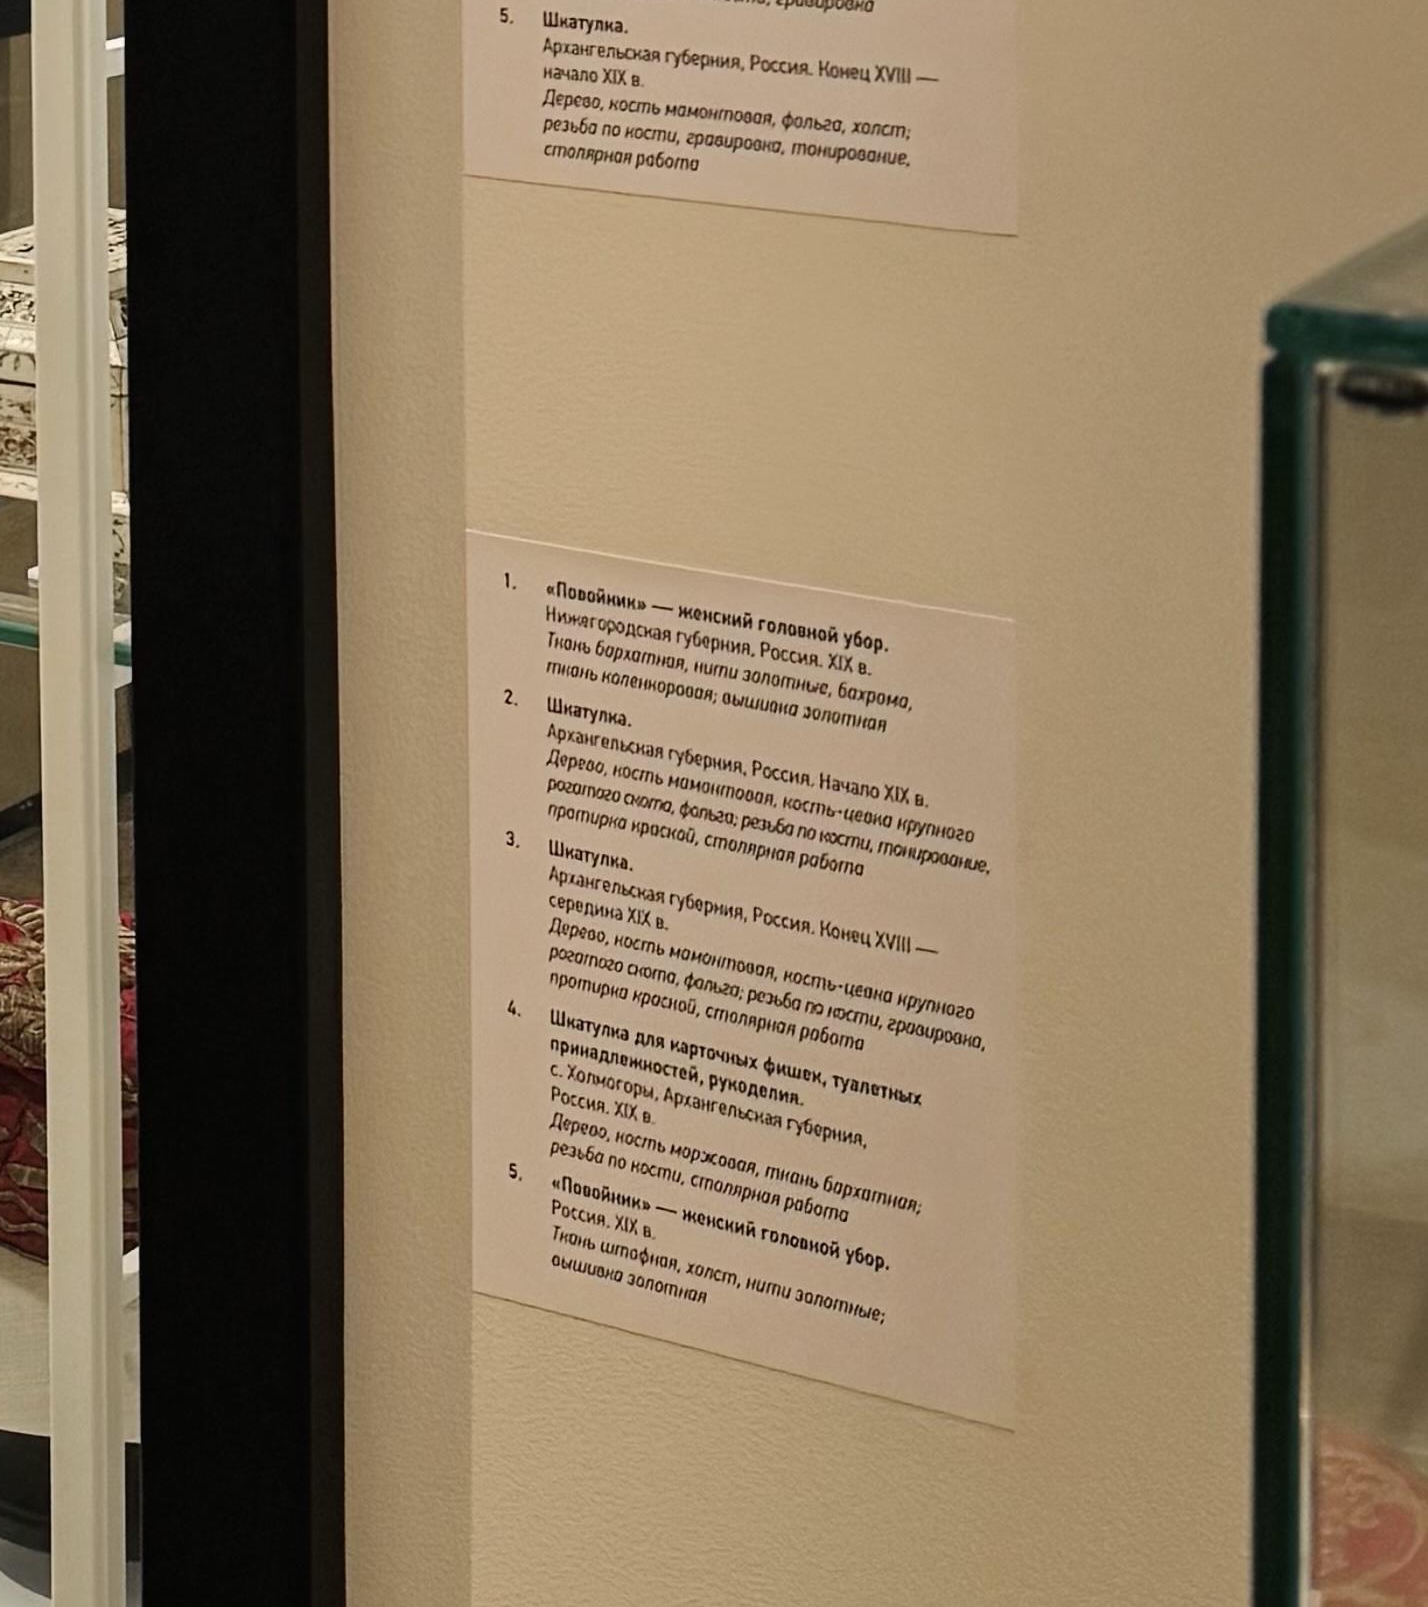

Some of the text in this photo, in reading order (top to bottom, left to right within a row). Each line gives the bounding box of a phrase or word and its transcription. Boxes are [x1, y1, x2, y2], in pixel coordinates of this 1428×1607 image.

[498, 6, 629, 36] 5. Шкатулка.
[542, 65, 599, 84] начало
[601, 67, 628, 87] XIX
[664, 47, 746, 73] губерния,
[748, 53, 814, 77] Россия.
[817, 59, 872, 84] Конец
[873, 63, 912, 85] XVIII
[540, 87, 912, 141] Дерево, кость мамонтовая, фольга, холст;
[542, 143, 700, 172] столярная работа
[503, 571, 889, 656] 1. «Повойник» женский головной убор.
[675, 629, 756, 658] губерния,
[759, 640, 824, 668] Россия.
[827, 652, 854, 674] XIX
[503, 687, 632, 728] 2. Шкатулка.
[667, 747, 748, 778] губерния,
[751, 758, 815, 788] Россия.
[818, 770, 881, 800] Начало
[883, 783, 910, 806] XIX
[504, 829, 634, 872] 3. Шкатулка.
[506, 998, 923, 1107] 4. Шкатулка для карточных фишек, туалетных
[550, 1084, 610, 1115] Россия.
[613, 1099, 639, 1122] XIX
[566, 1062, 659, 1103] Холмогоры,
[785, 1117, 868, 1150] губерния,
[708, 1072, 805, 1107] рукоделия.
[508, 1161, 890, 1273] 5. «Повойник» женский головной убор.
[552, 1224, 886, 1326] Ткань штофная, холст, нити золотные;
